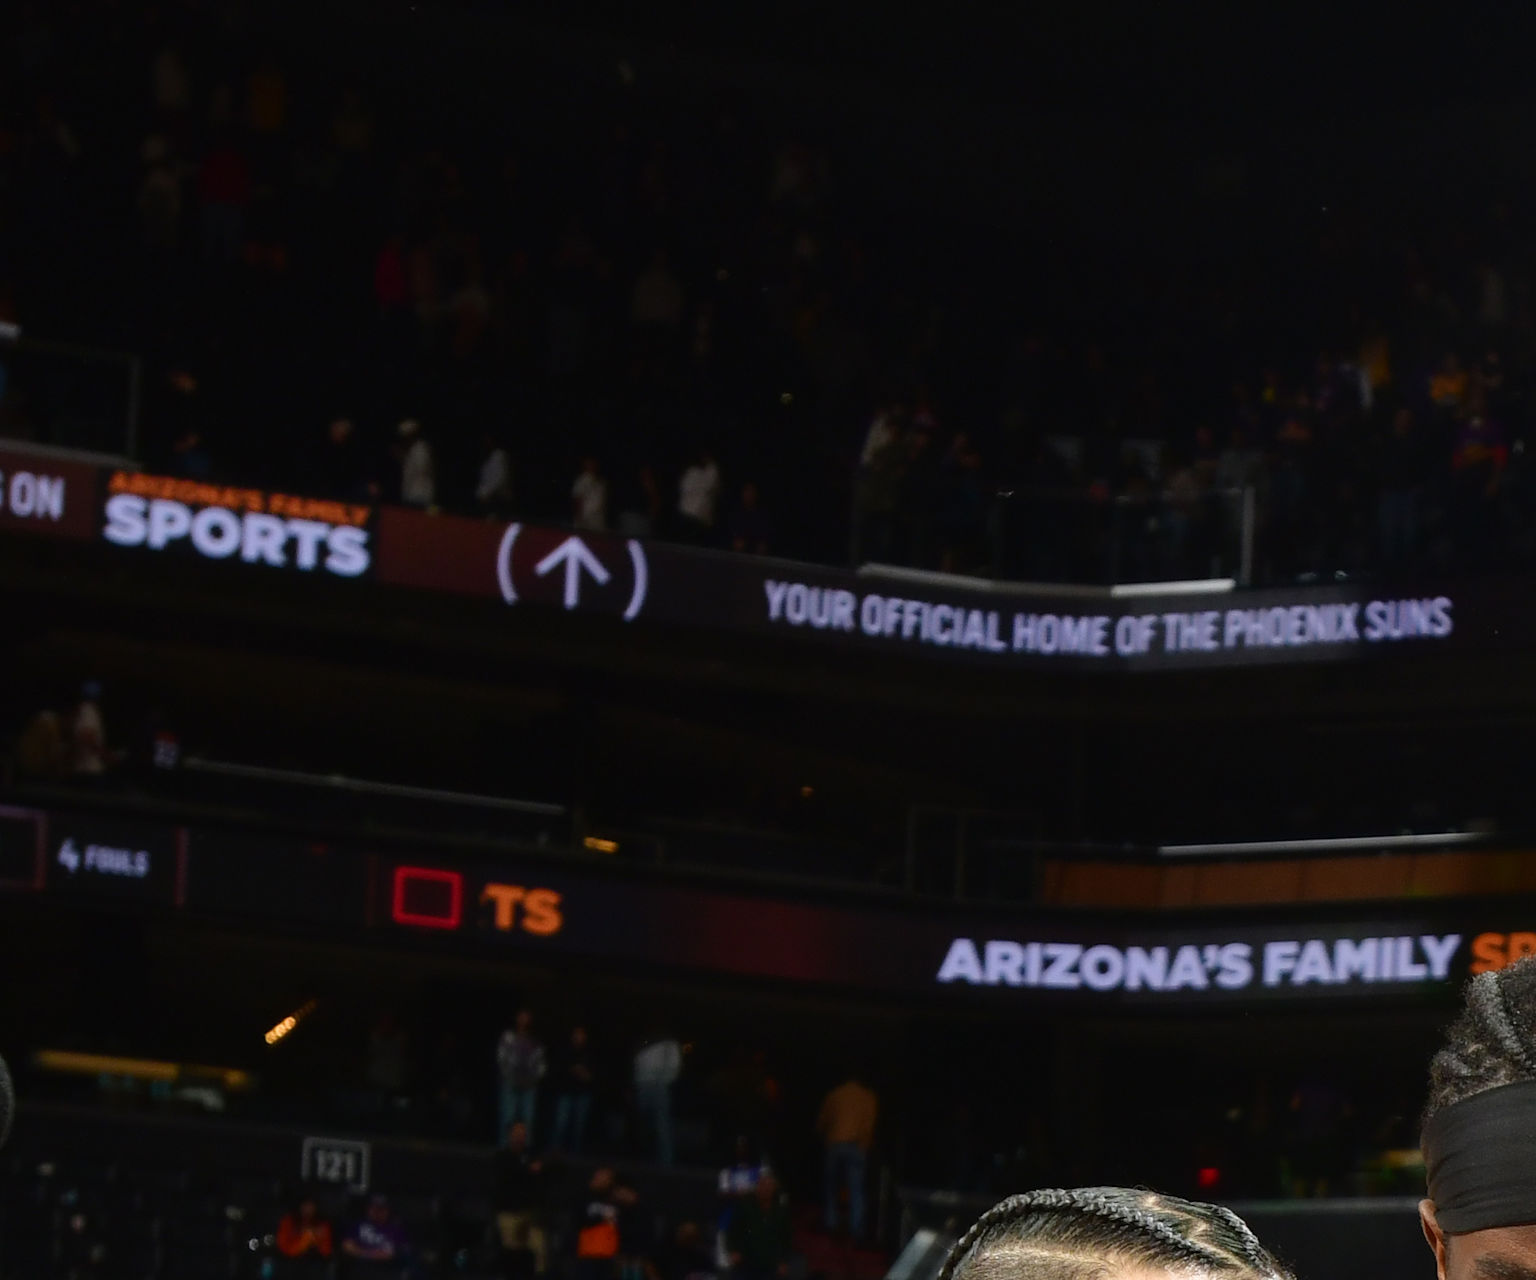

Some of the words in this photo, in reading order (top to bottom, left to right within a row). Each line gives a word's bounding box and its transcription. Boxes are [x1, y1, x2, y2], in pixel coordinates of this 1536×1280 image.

[9, 471, 66, 520] ON
[102, 493, 372, 577] SPORTS
[763, 578, 856, 632] YOUR
[860, 592, 1007, 653] OFFICIAL
[1012, 612, 1111, 657] HOME
[1114, 614, 1158, 657] OF
[1161, 610, 1221, 653] THE
[1223, 602, 1360, 648] PHOENIX
[1363, 595, 1454, 641] SUNS
[935, 936, 1253, 992] ARIZONA'S
[1262, 932, 1463, 986] FAMILY
[316, 1150, 356, 1182] 121
